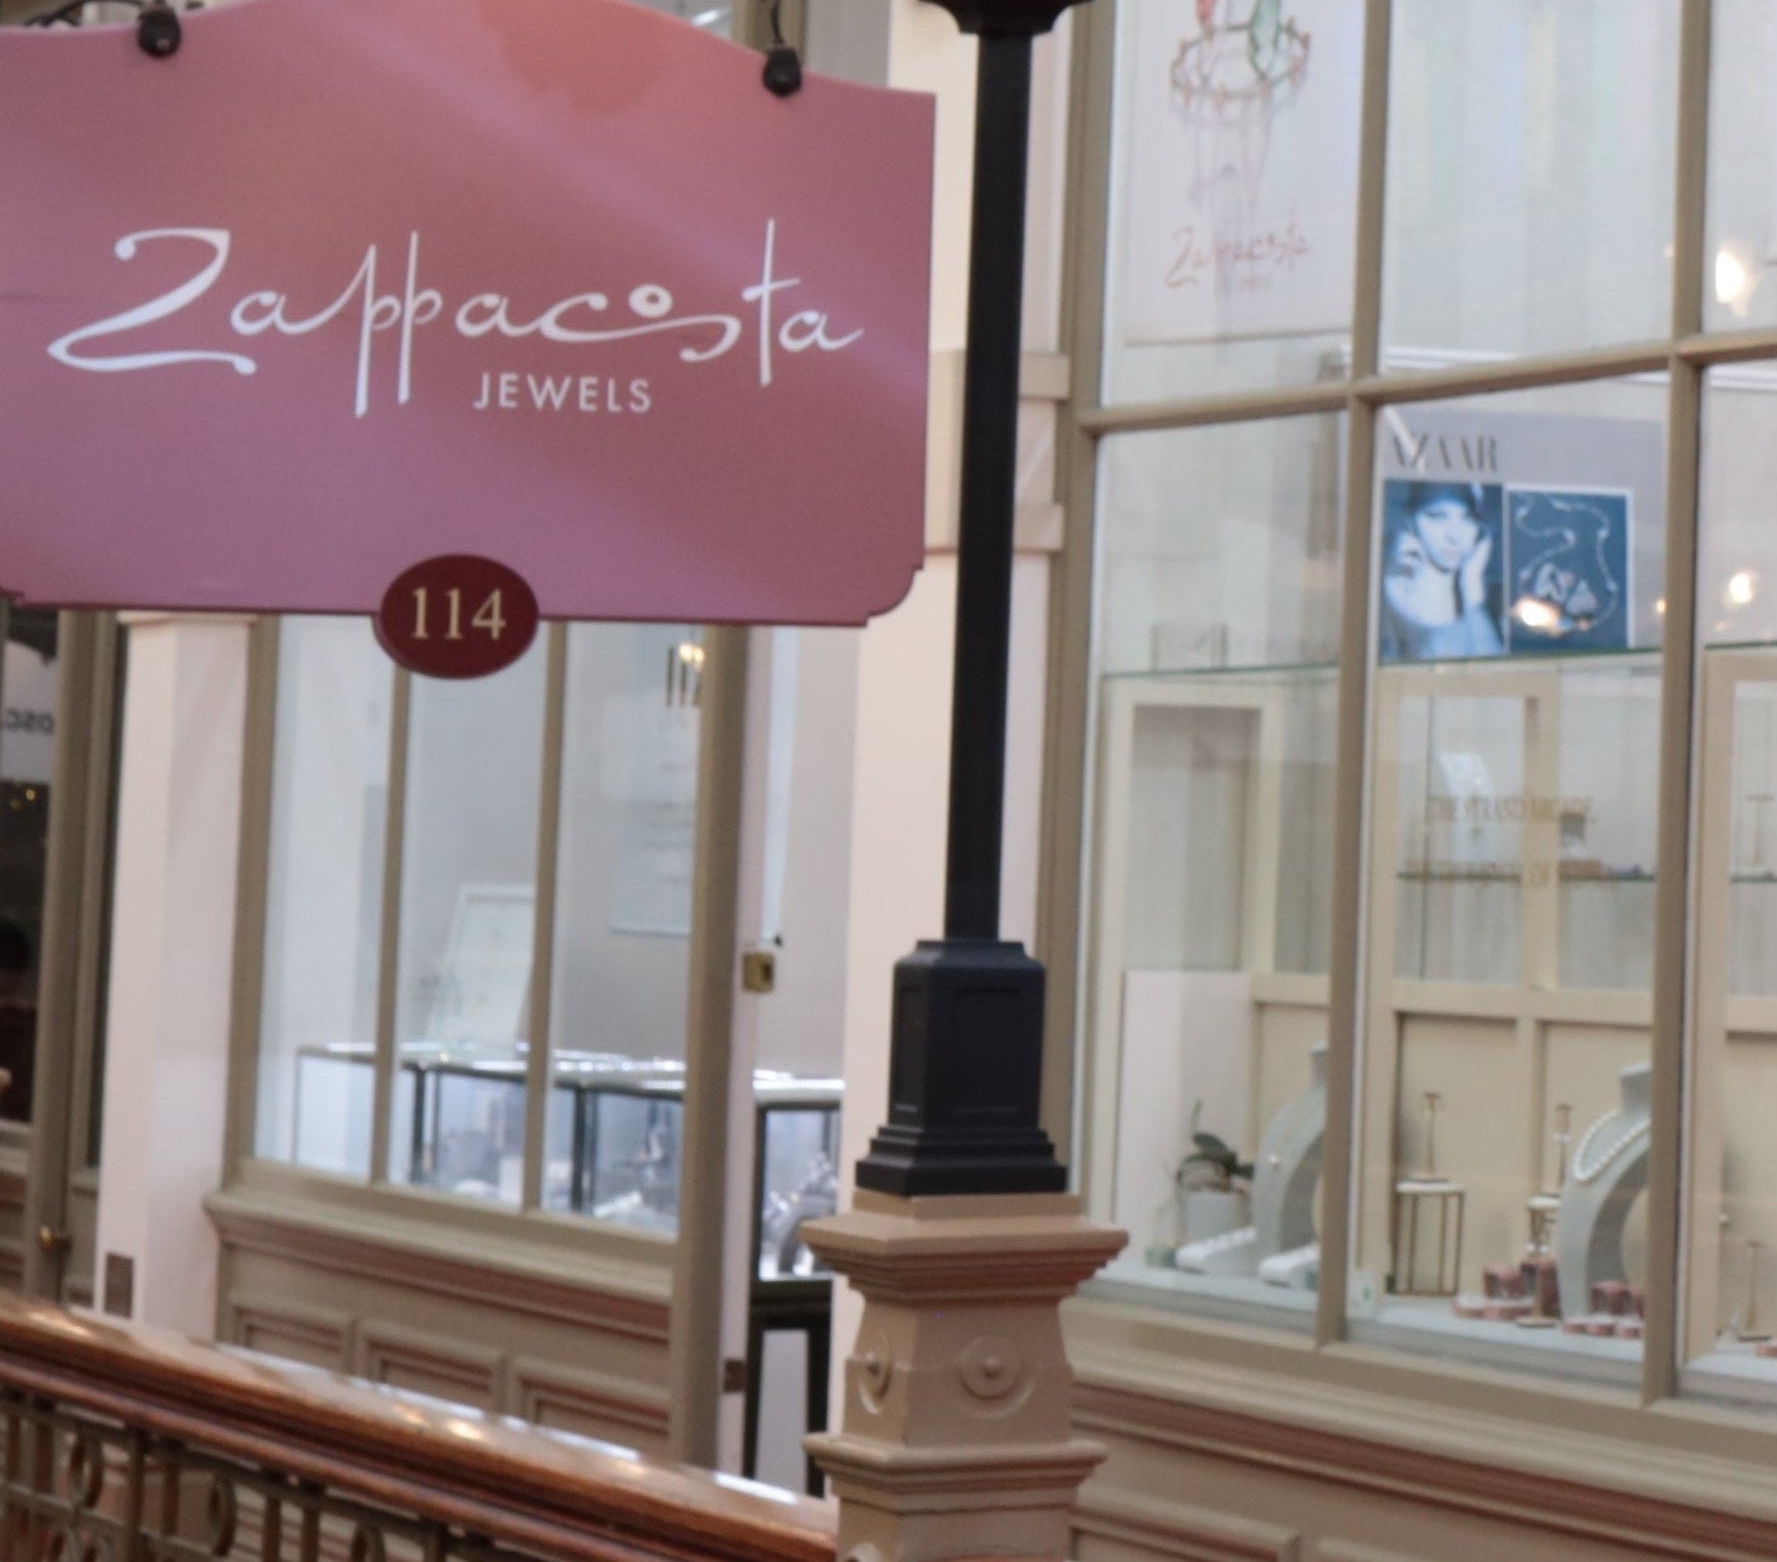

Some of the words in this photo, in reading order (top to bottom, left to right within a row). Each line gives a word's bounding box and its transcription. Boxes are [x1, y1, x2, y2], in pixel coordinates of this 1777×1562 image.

[47, 218, 864, 418] Zappacosta
[474, 373, 652, 413] JEWELS
[410, 588, 508, 640] 114
